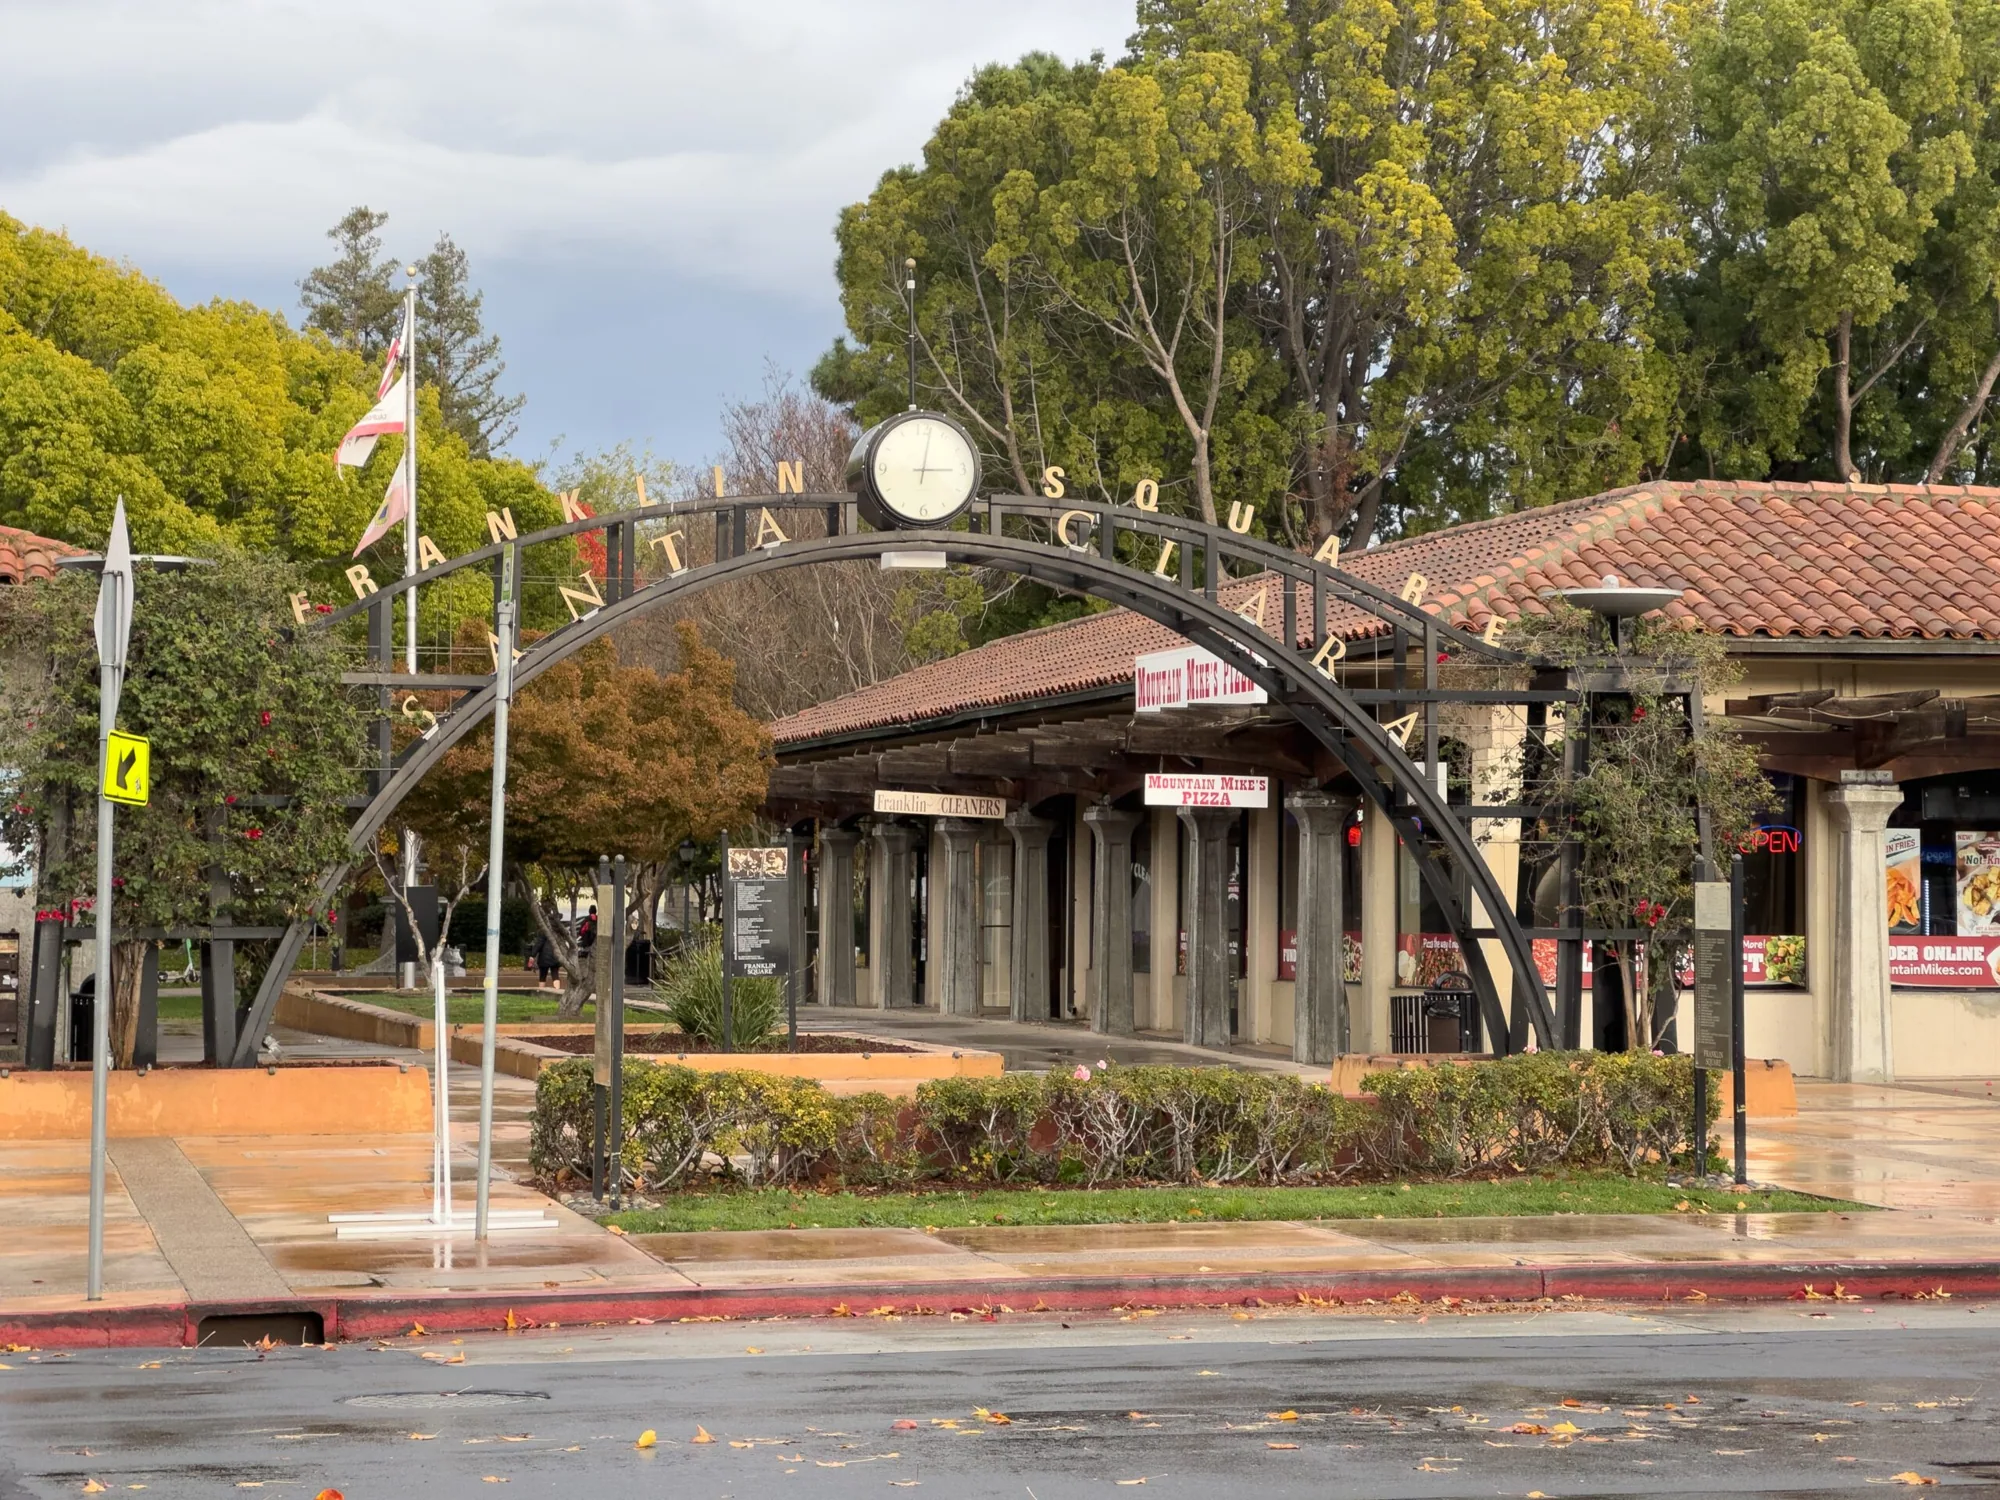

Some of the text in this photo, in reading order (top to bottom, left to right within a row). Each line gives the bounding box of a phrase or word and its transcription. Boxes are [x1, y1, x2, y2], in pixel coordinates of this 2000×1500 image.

[878, 463, 887, 475] 9
[959, 463, 967, 475] 3
[919, 505, 928, 516] 6
[290, 461, 1508, 649] FRANKLIN SQUARE
[1058, 510, 1418, 747] CLARA
[1138, 667, 1181, 708] MOUNTAIN
[1187, 658, 1218, 700] MIKE'S
[1148, 775, 1266, 791] MOUNTAIN MIKE'S
[876, 794, 1001, 816] Franklin CLEANERS
[1182, 791, 1231, 805] PIZZA
[1739, 831, 1798, 853] OPEN
[1895, 839, 1916, 850] FRIES
[1923, 945, 1985, 961] ONLINE
[1890, 963, 1983, 975] ntainMikes.com
